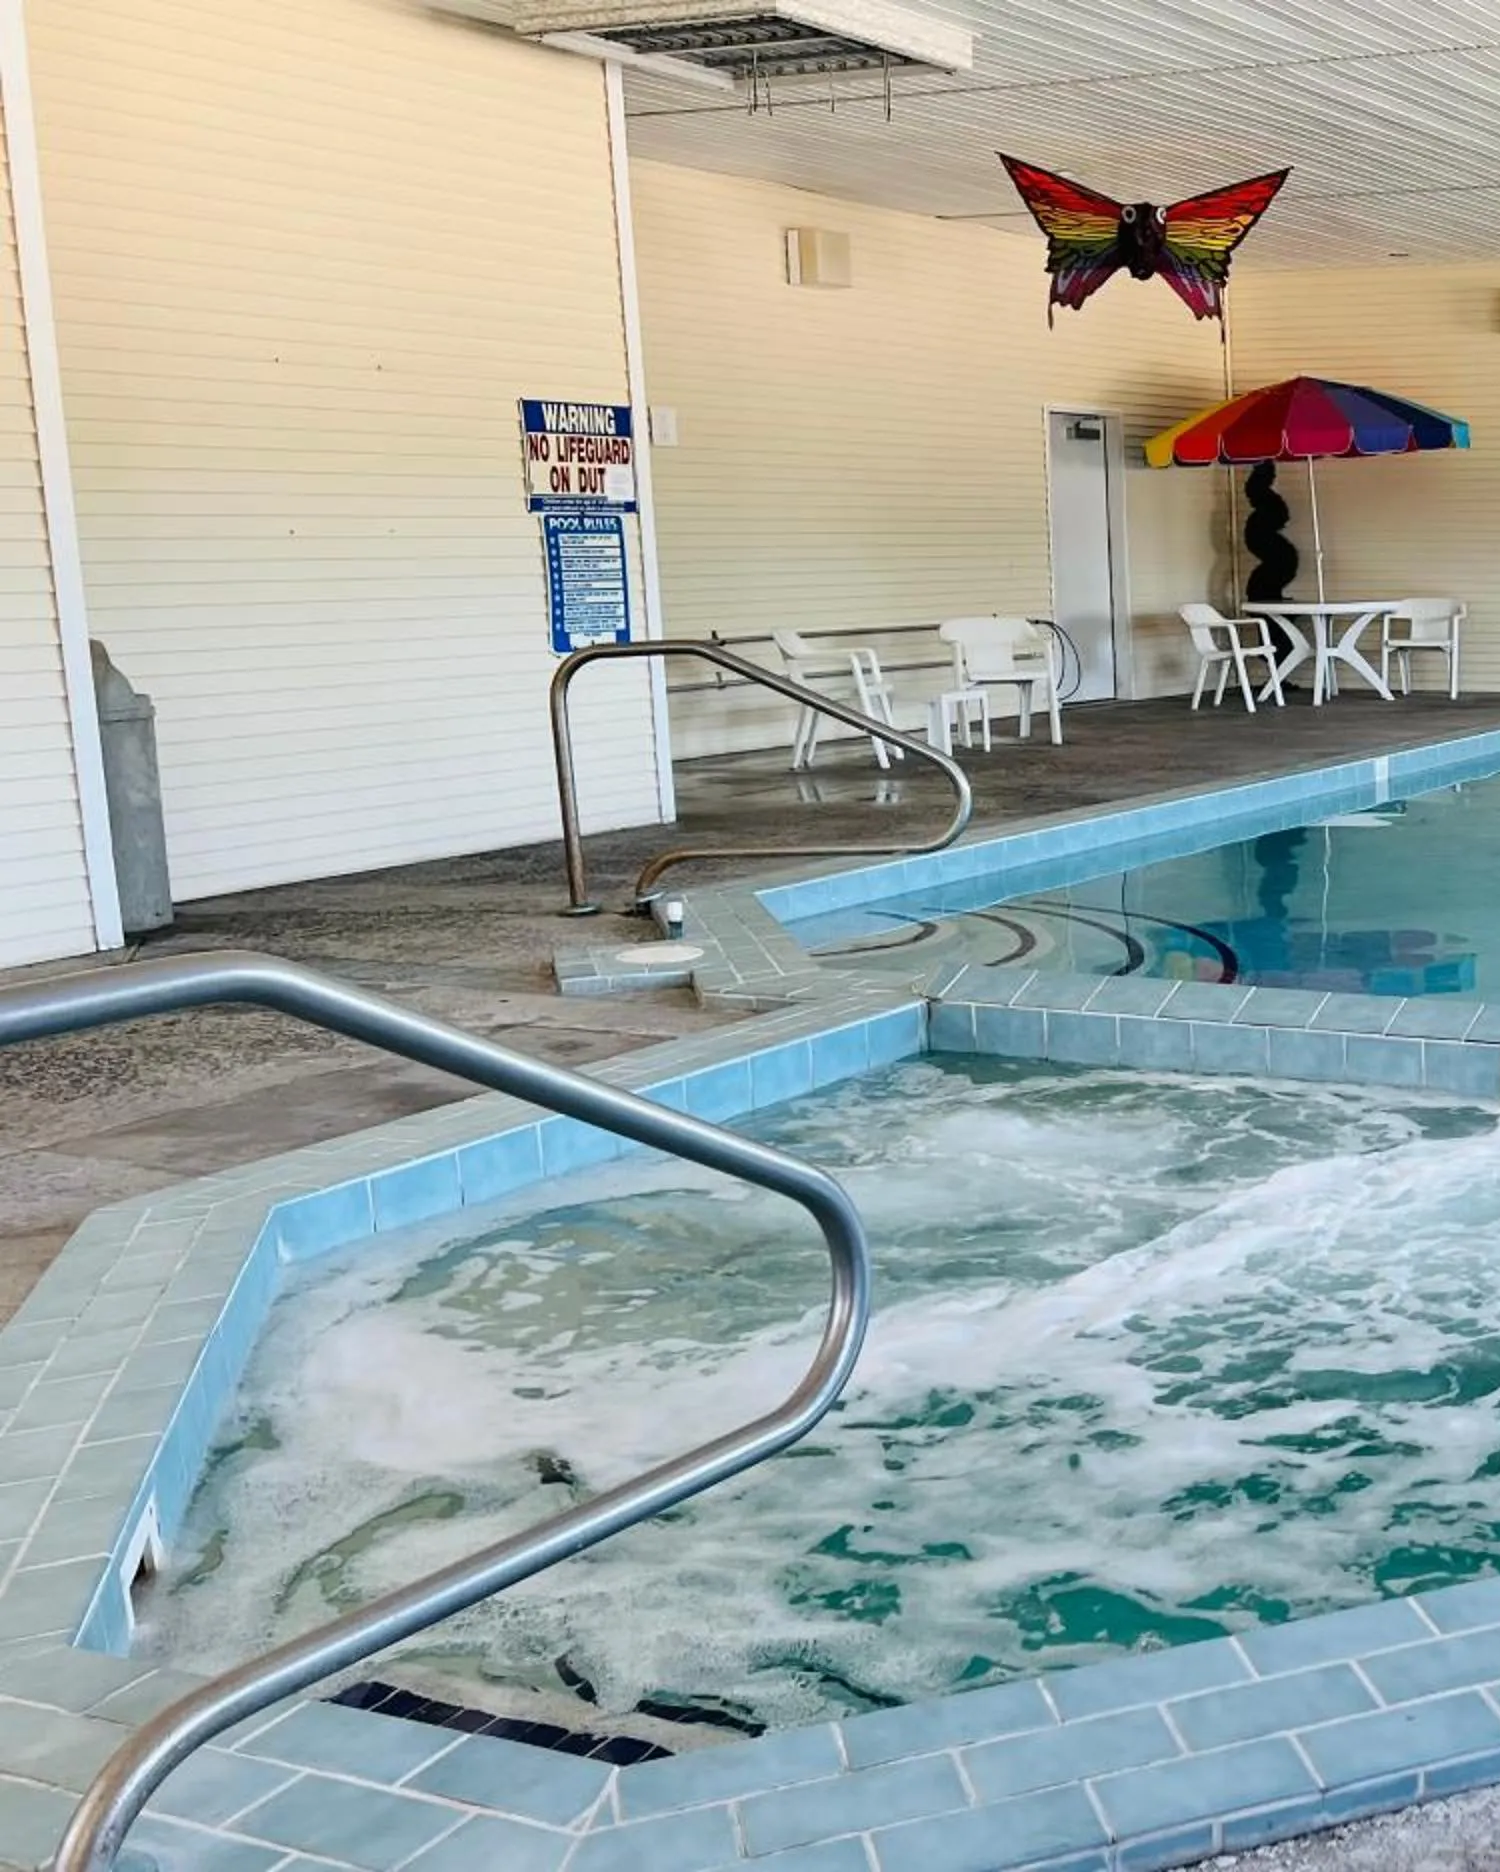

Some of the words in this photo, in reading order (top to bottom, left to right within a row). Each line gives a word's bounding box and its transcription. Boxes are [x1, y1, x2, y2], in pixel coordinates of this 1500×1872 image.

[542, 403, 616, 434] WARNING
[528, 434, 549, 462] NO
[557, 437, 629, 464] LIFEGUARD
[550, 466, 570, 493] ON
[579, 468, 606, 494] DUT
[549, 517, 582, 531] POOL
[583, 517, 617, 531] RULES
